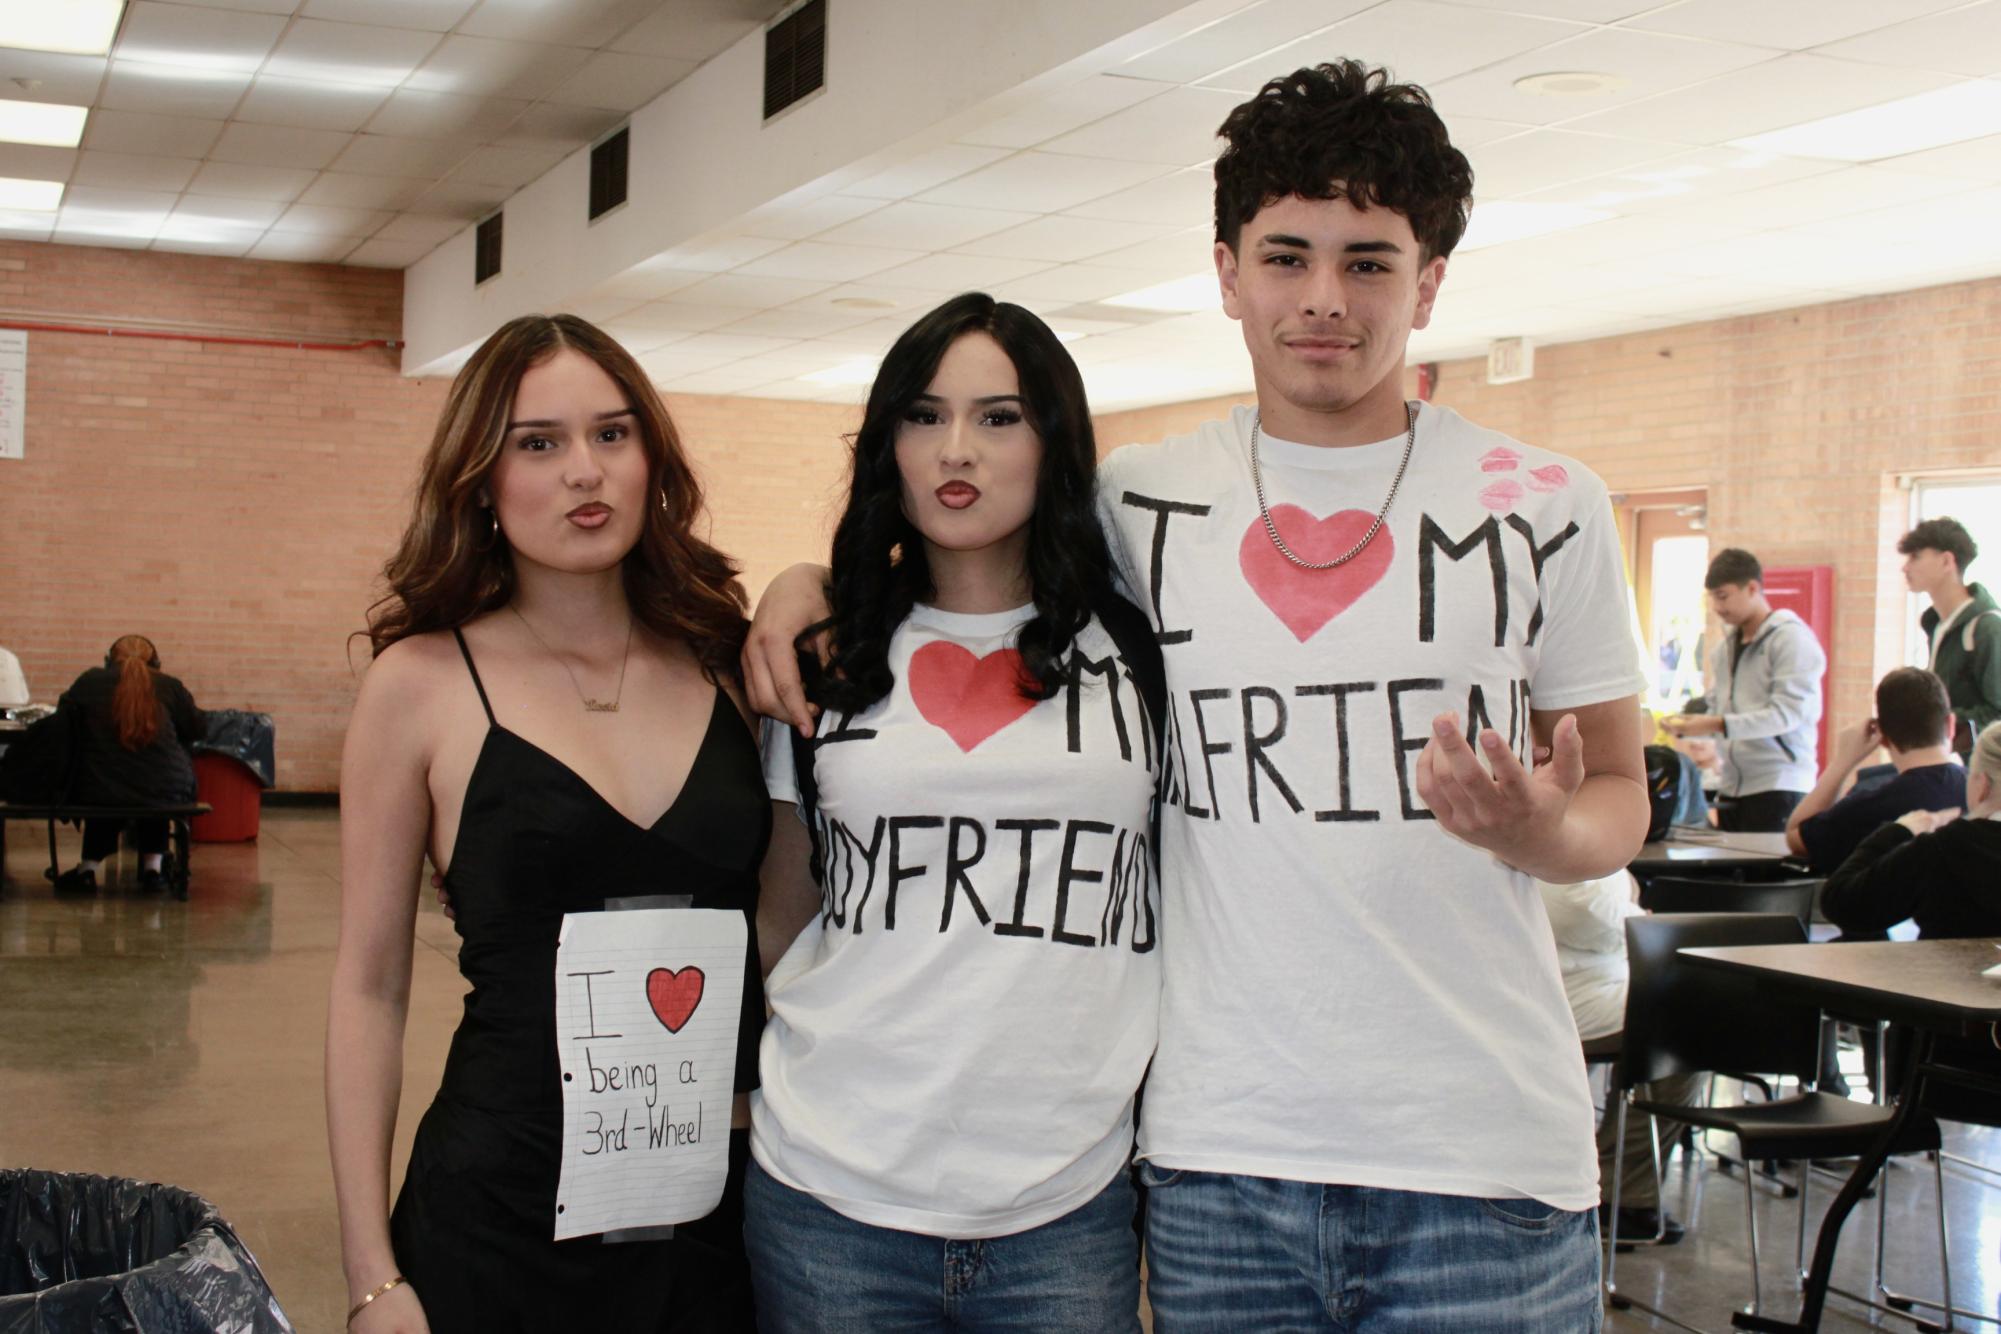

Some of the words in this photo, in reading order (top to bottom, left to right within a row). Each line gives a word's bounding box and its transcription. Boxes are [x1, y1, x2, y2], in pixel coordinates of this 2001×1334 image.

[1121, 490, 1212, 645] I
[1418, 511, 1580, 648] MY
[567, 970, 623, 1041] I
[585, 1046, 658, 1108] being
[679, 1059, 698, 1084] a
[582, 1101, 702, 1156] 3rd-Wheel
